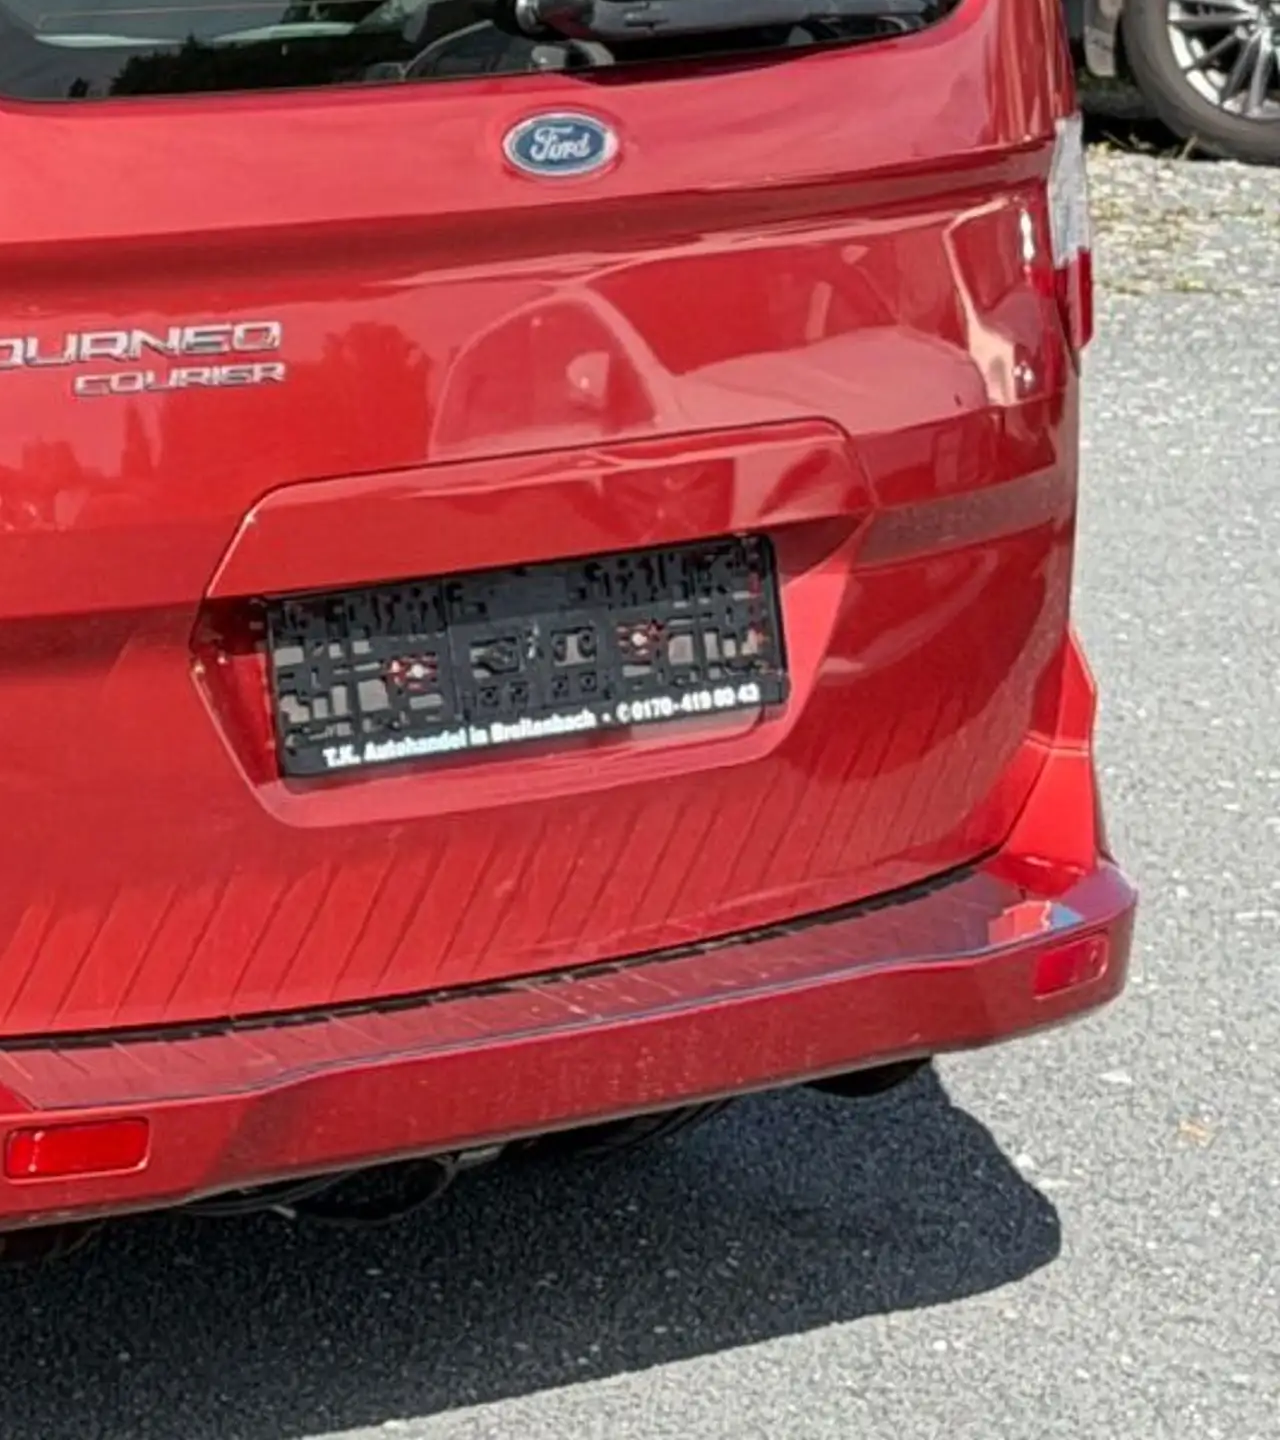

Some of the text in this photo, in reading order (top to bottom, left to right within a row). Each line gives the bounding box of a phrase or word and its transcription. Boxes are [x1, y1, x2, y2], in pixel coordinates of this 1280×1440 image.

[529, 125, 591, 161] Ford
[74, 361, 286, 396] COURIER
[363, 726, 466, 763] Autohandel
[469, 725, 488, 746] in
